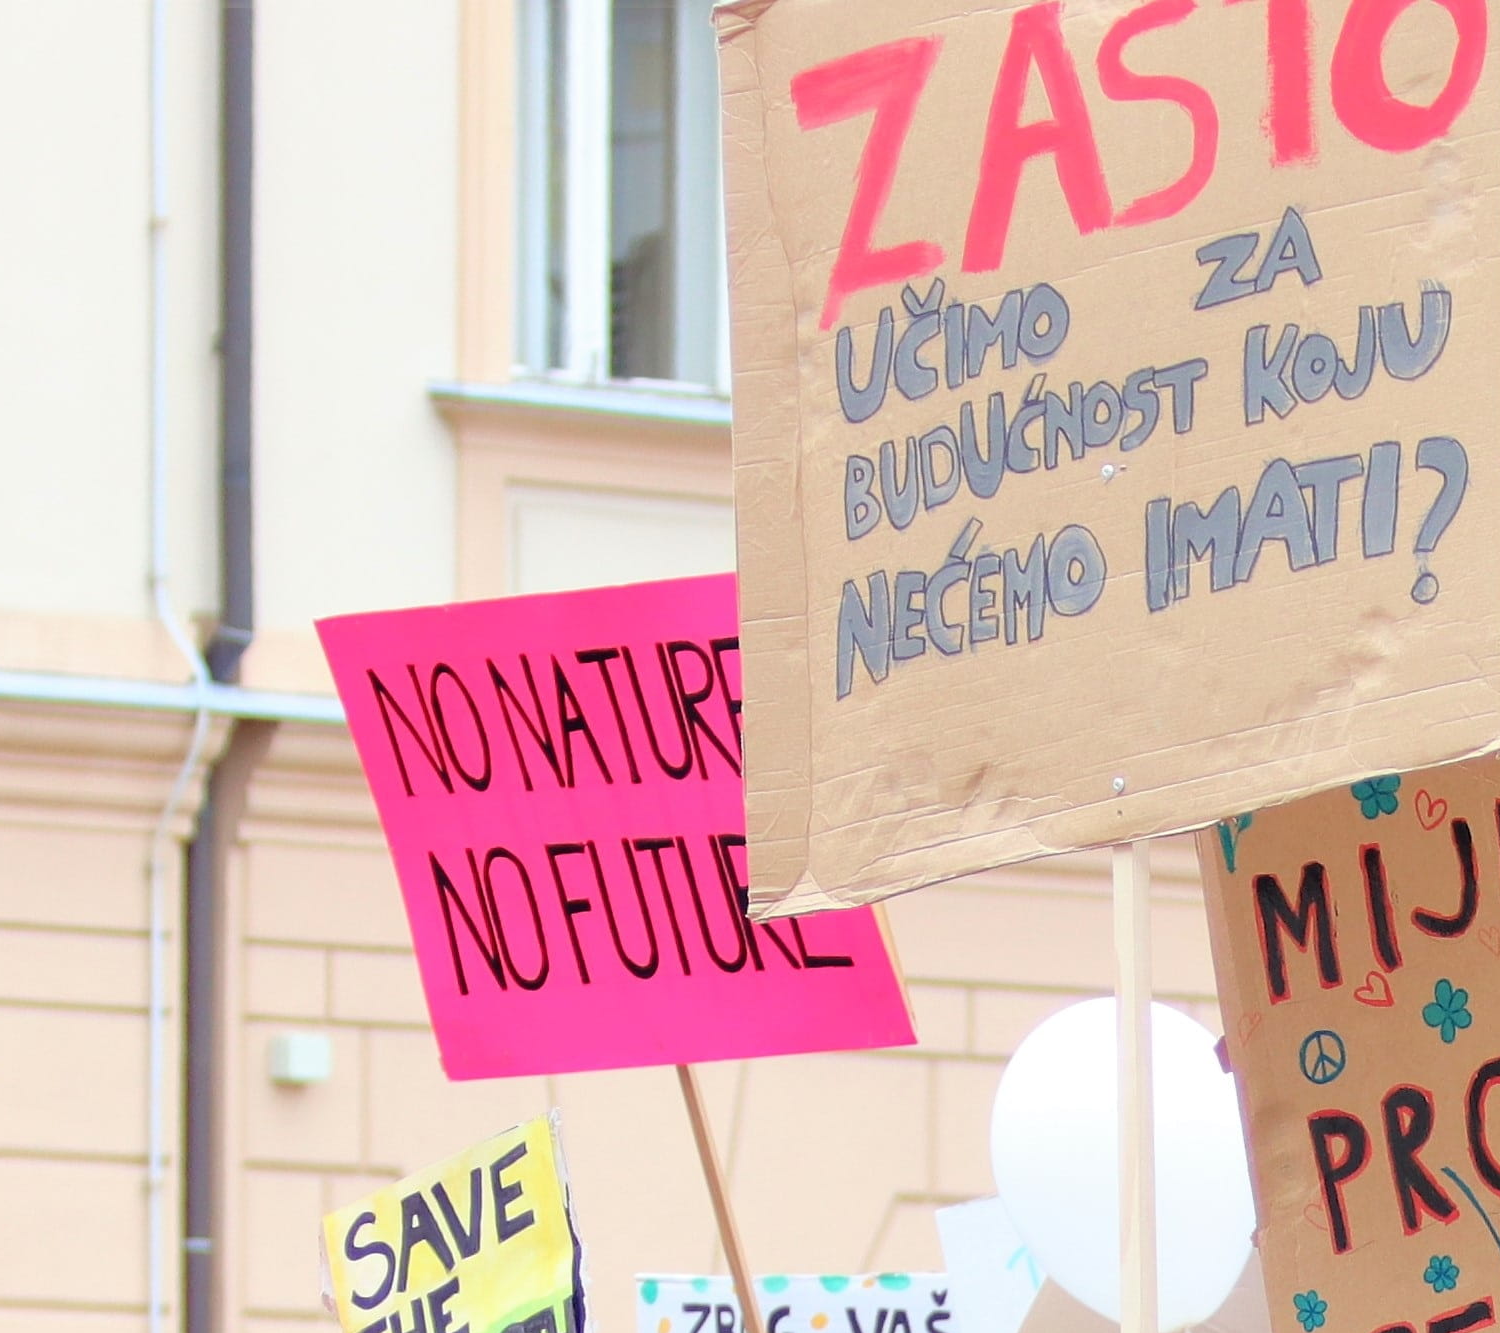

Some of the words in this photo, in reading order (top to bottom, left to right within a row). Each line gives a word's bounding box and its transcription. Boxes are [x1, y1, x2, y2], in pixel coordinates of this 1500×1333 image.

[836, 278, 1070, 424] UČIMO
[1194, 206, 1323, 310] ZA
[844, 357, 1209, 541] BUDUĆNOST
[1243, 281, 1453, 427] KOJU
[836, 517, 1109, 702] NEĆEMO
[1144, 436, 1469, 615] IMATI?
[367, 661, 492, 797] NO
[429, 844, 549, 997] NO
[344, 1141, 536, 1311] SAVE
